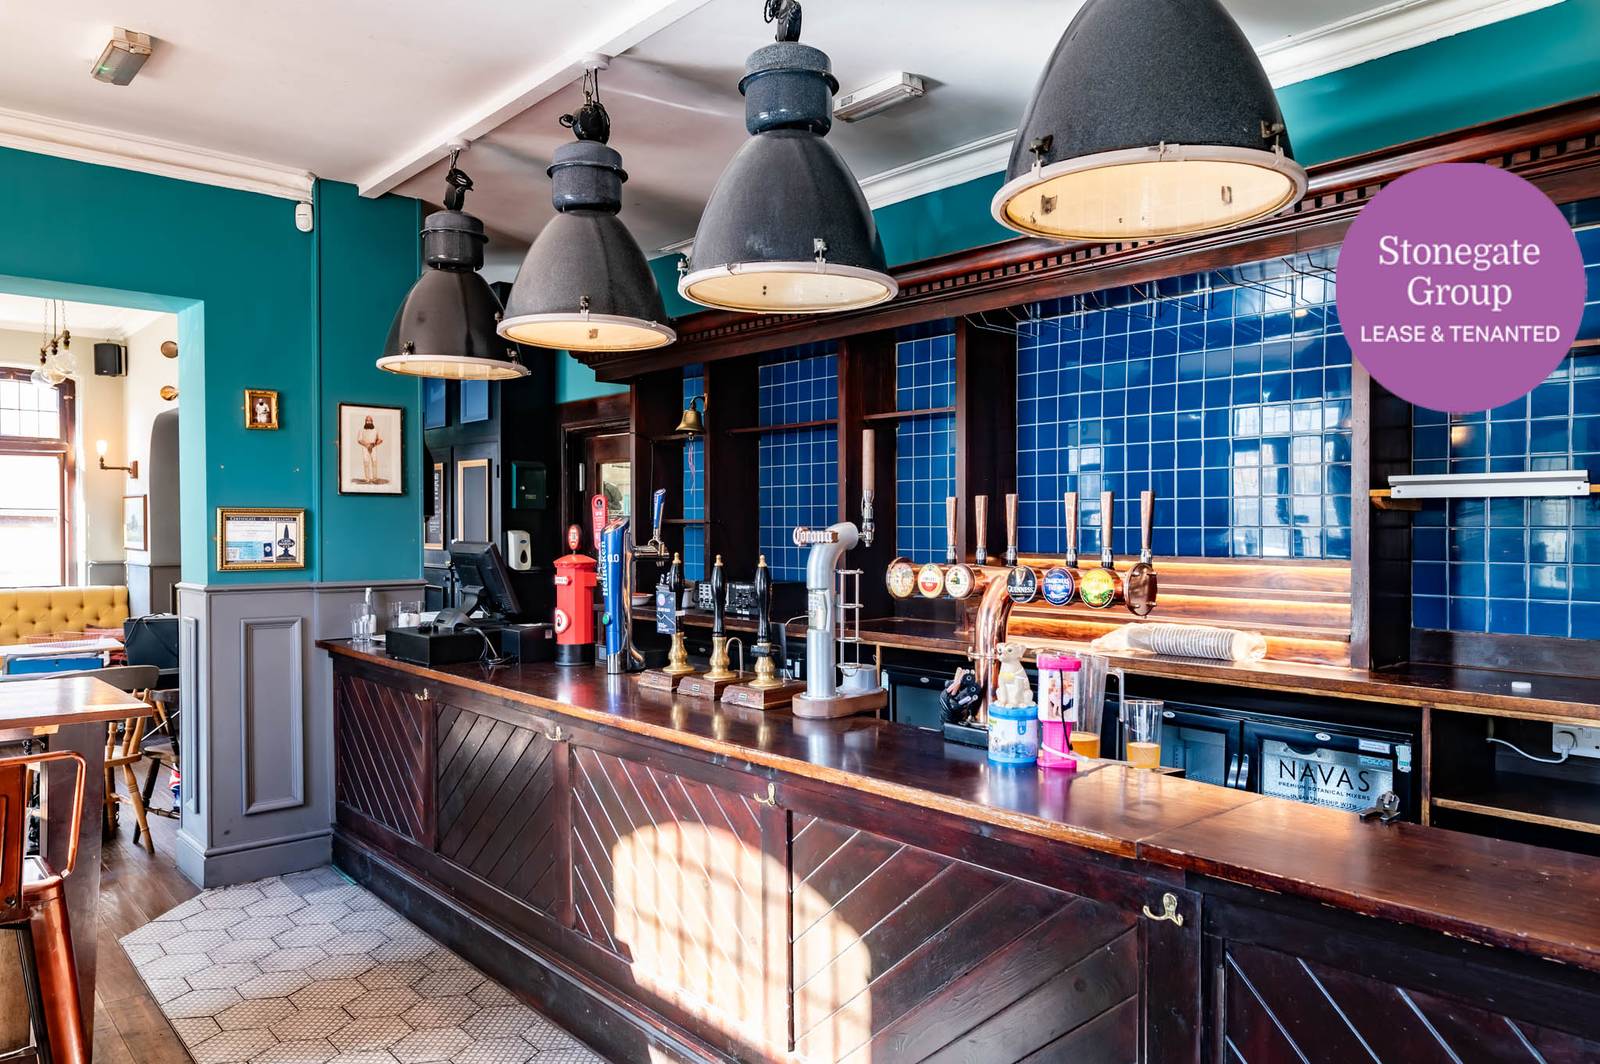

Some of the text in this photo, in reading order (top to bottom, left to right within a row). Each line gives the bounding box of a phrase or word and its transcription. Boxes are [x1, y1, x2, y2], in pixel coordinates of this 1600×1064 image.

[793, 526, 833, 547] Corona
[1007, 585, 1034, 593] GUINNESS
[1279, 759, 1370, 793] NAVAS
[1278, 781, 1371, 801] PREMIUM BOTANICAL MIXERS
